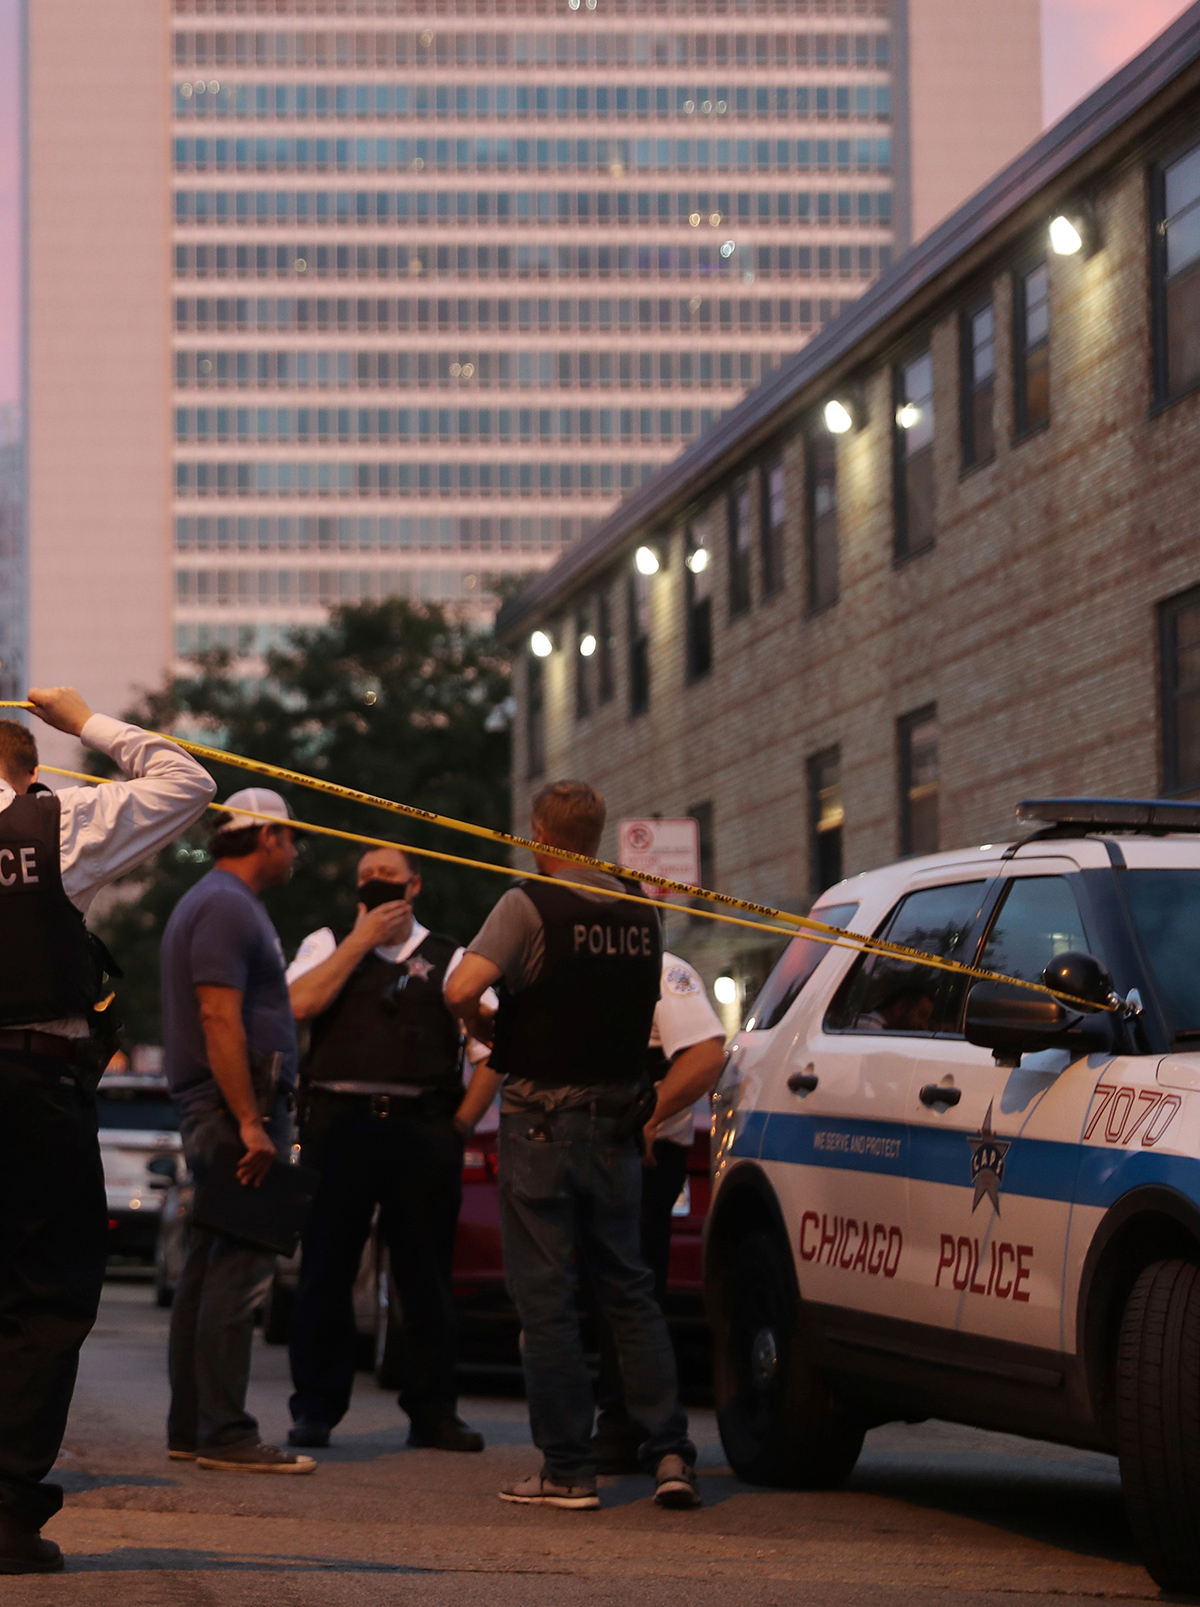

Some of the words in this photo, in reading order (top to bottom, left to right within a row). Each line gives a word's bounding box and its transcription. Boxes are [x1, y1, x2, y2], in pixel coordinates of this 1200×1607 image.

[573, 924, 652, 956] POLICE
[1082, 1083, 1182, 1147] 7070
[813, 1131, 827, 1150] WE
[825, 1132, 851, 1152] SERVE
[850, 1134, 866, 1154] AND
[865, 1136, 902, 1158] PROTECT
[800, 1210, 904, 1279] CHICAGO
[935, 1233, 1034, 1302] POLICE
